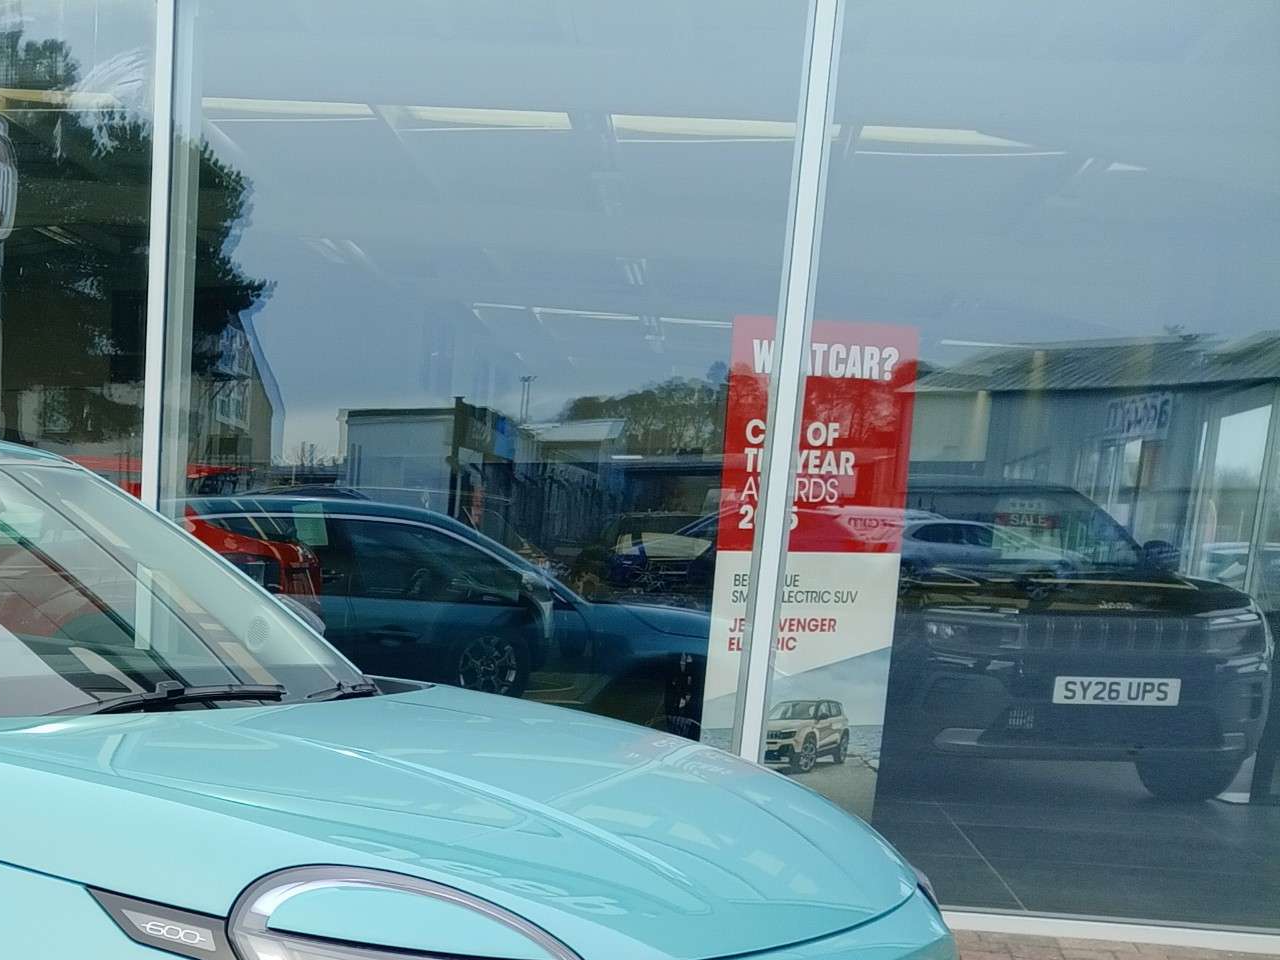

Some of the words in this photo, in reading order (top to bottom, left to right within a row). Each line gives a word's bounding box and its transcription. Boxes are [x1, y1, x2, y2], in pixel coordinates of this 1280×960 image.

[752, 338, 900, 381] WTCAR?
[806, 421, 840, 447] OF
[740, 476, 839, 503] ARDS
[781, 590, 832, 604] LECTRIC
[833, 590, 858, 604] SUV
[778, 618, 837, 633] VENGER
[1063, 681, 1121, 701] SY26
[1127, 682, 1170, 701] UPS
[143, 921, 204, 944] 600
